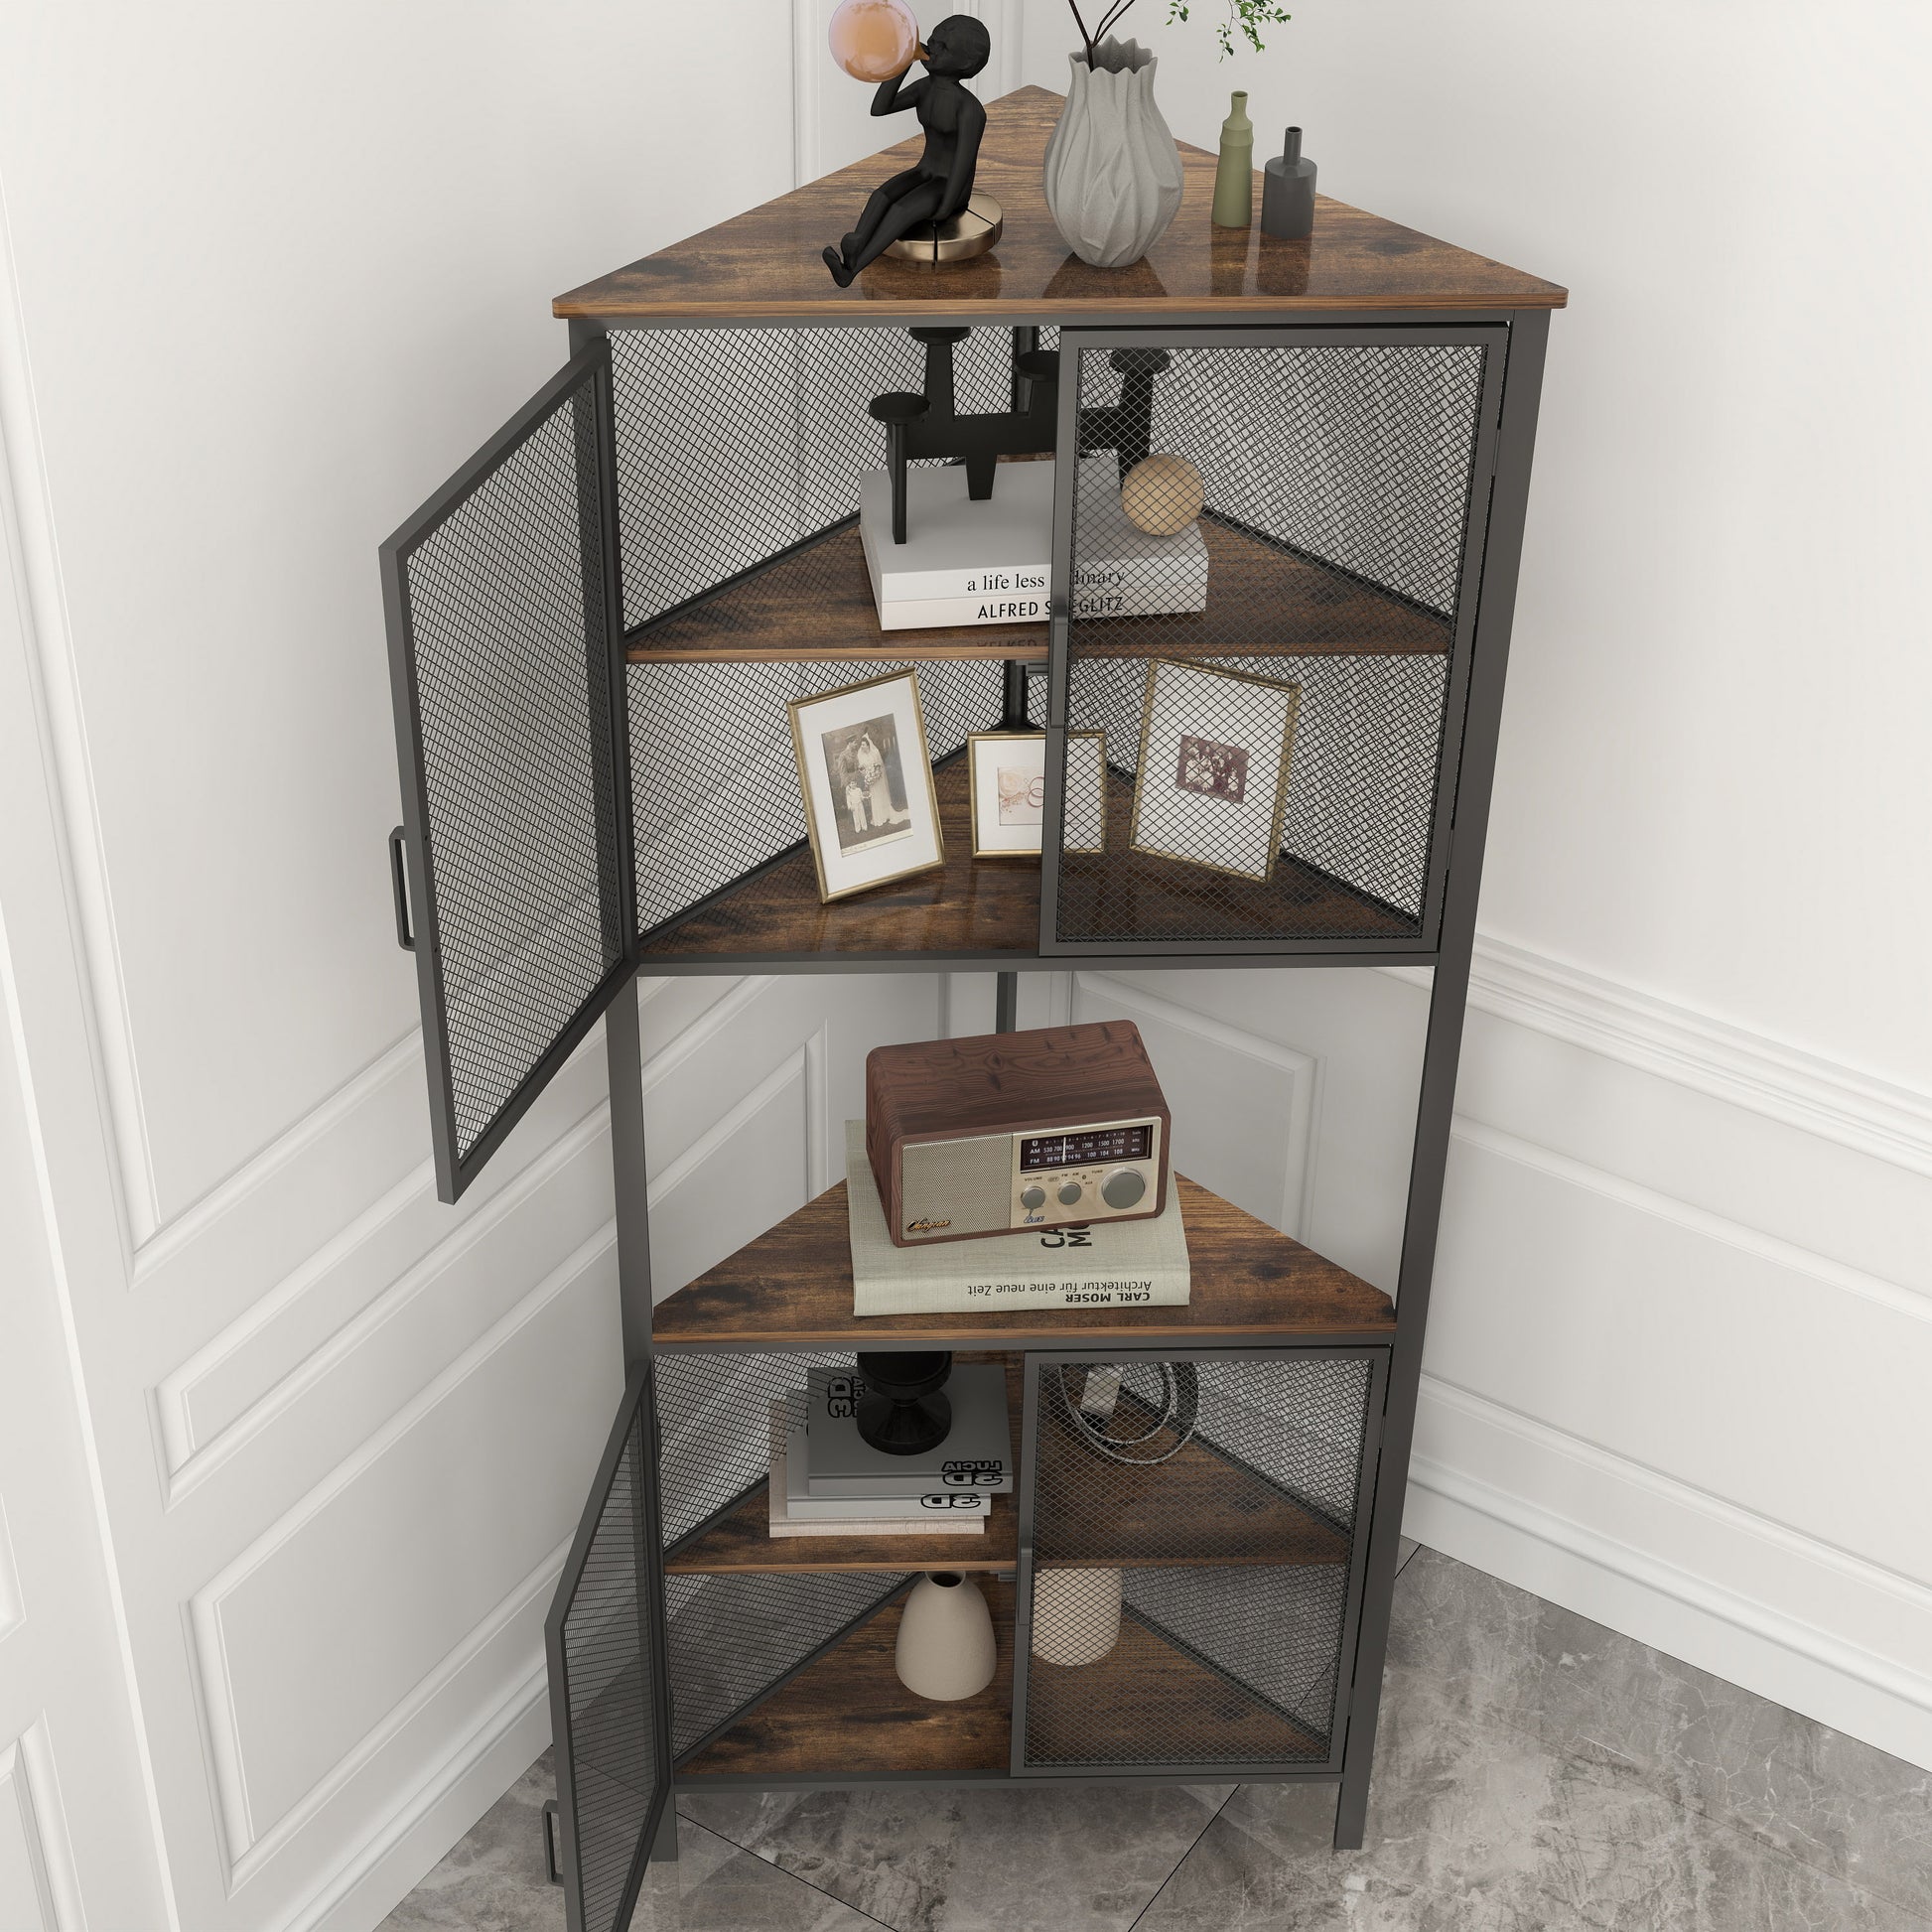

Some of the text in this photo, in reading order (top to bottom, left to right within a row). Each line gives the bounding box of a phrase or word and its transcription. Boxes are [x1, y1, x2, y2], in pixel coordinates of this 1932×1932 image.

[967, 580, 977, 592] a
[983, 574, 1010, 591] life
[1015, 573, 1045, 589] less
[977, 601, 1038, 619] ALFRED
[967, 1281, 1152, 1297] Architektur für eine neue Zeit
[1065, 1292, 1151, 1303] CARL MOSER
